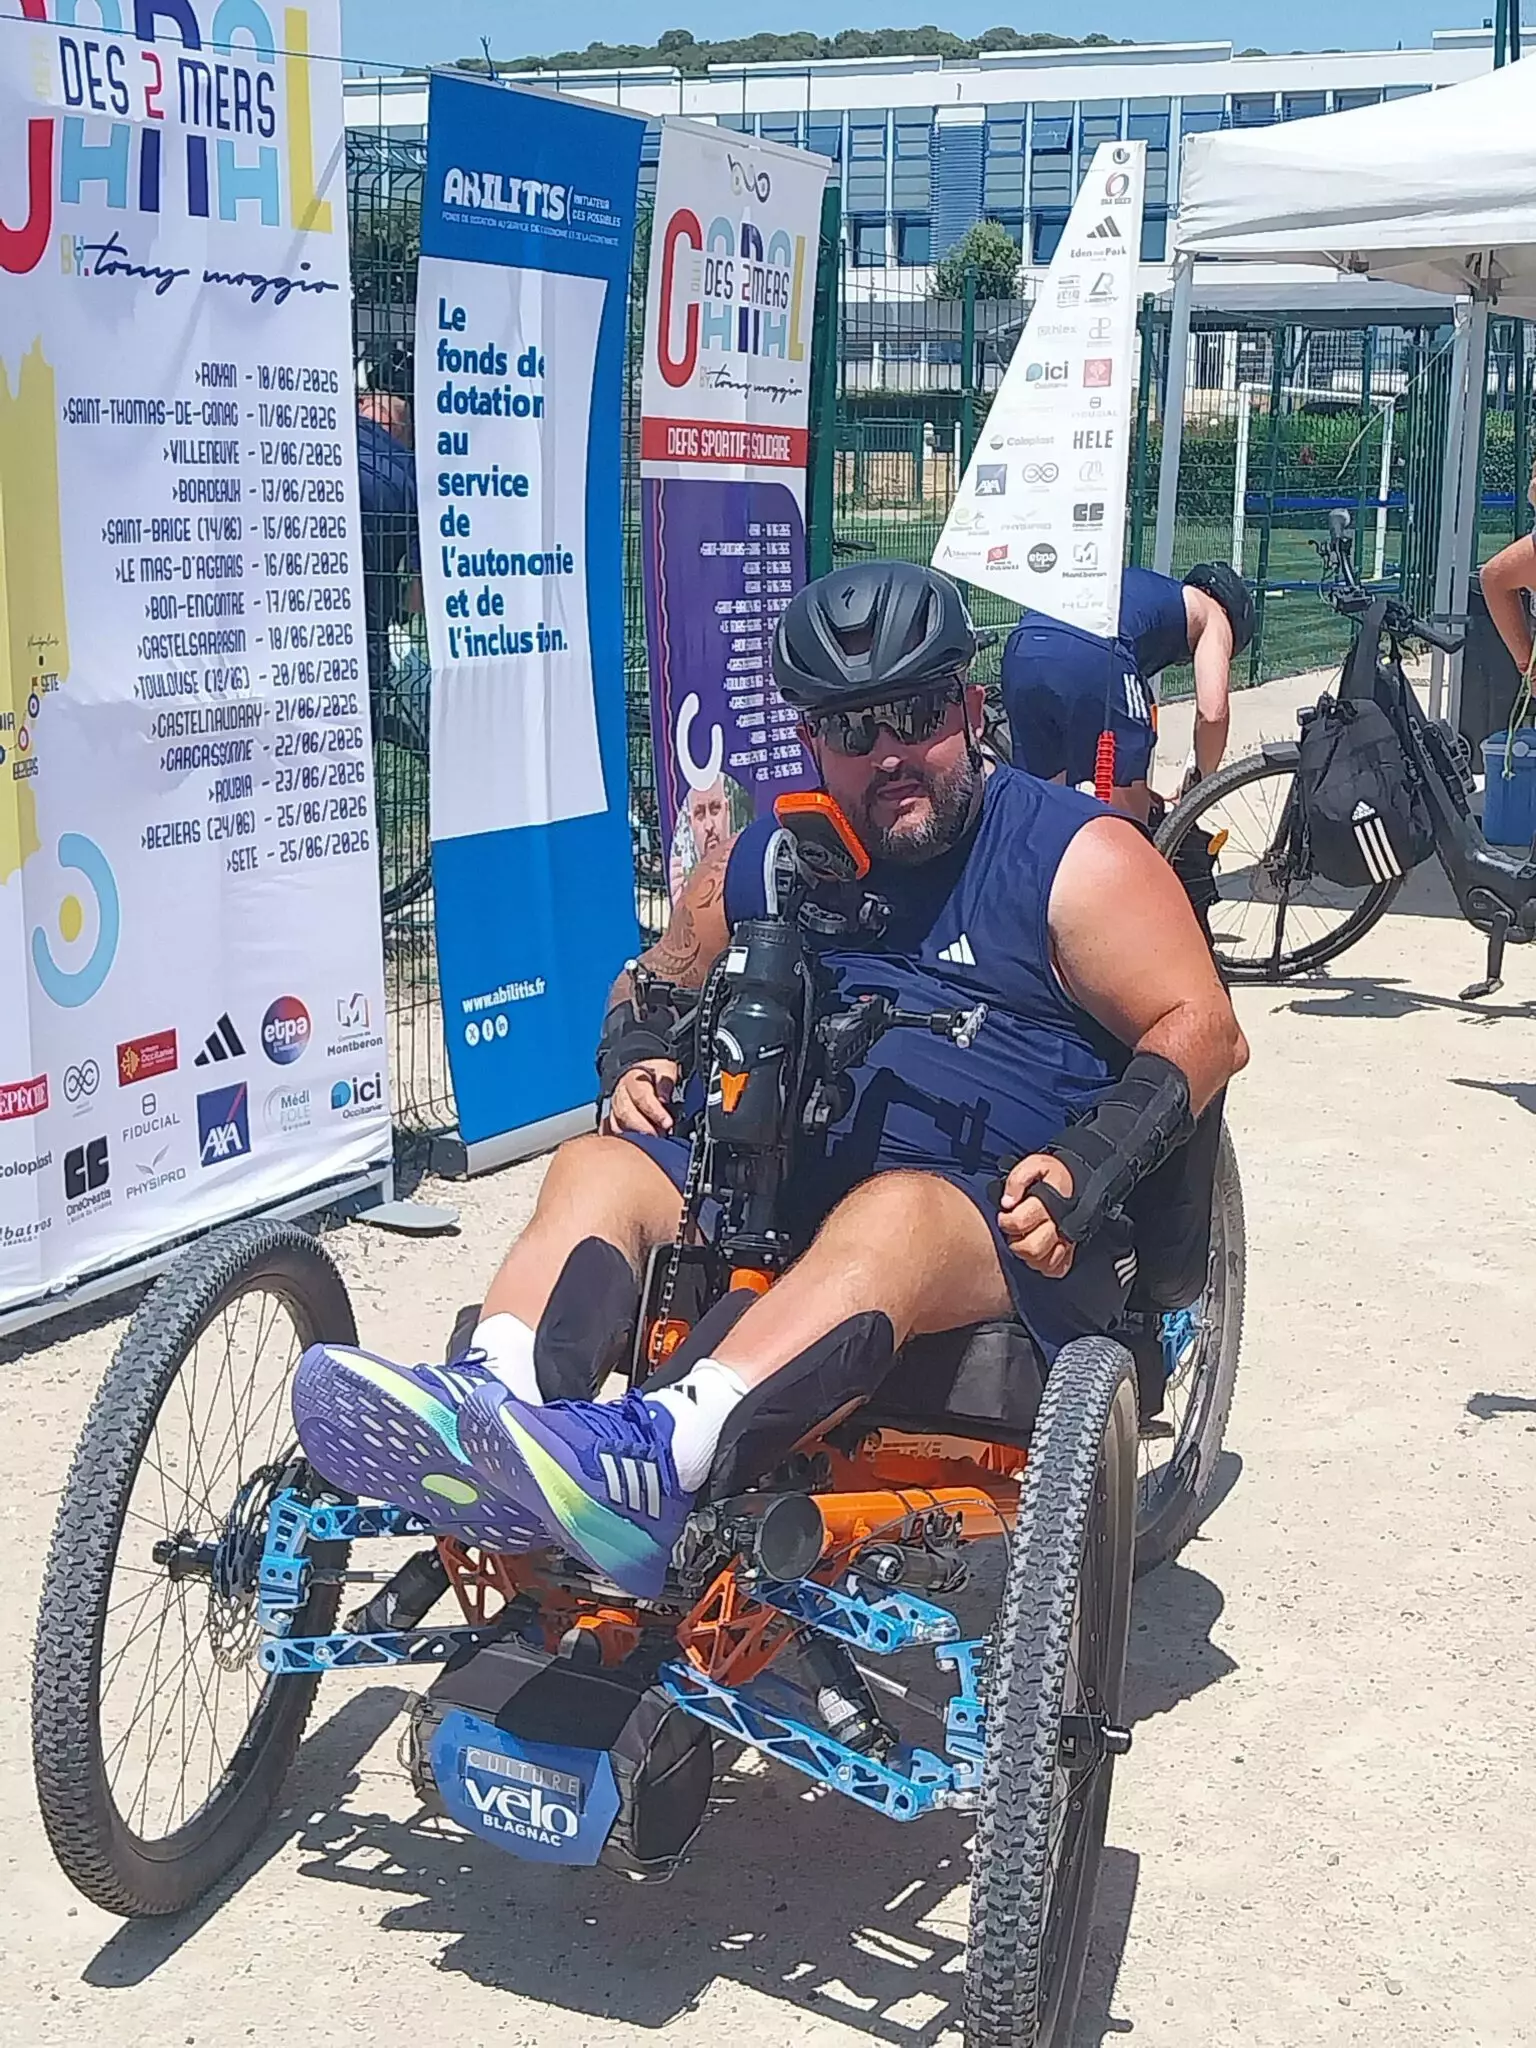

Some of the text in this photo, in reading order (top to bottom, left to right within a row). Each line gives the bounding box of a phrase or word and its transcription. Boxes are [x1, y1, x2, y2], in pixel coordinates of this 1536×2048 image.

[59, 36, 129, 114] DES
[141, 51, 164, 120] 2
[178, 57, 276, 138] MERS
[704, 258, 734, 299] DES
[741, 264, 751, 301] 2
[751, 266, 790, 310] MERS
[438, 298, 466, 331] Le
[436, 338, 507, 376] fonds
[1044, 360, 1069, 381] ici
[437, 381, 545, 418] dotation
[258, 403, 337, 430] 11/06/2026
[260, 441, 343, 466] 12/06/2026
[437, 431, 468, 455] au
[1073, 430, 1113, 449] HELE
[261, 479, 344, 502] 13/06/2026
[437, 465, 529, 497] service
[263, 516, 347, 539] 15/06/2026
[440, 505, 470, 537] de
[264, 552, 348, 576] 16/06/2026
[266, 587, 351, 613] 17/06/2026
[446, 584, 504, 618] et de
[268, 623, 353, 650] 18/06/2026
[271, 658, 358, 686] 20/06/2026
[275, 693, 358, 722] 21/06/2026
[275, 727, 363, 757] 22/06/2026
[275, 761, 365, 792] 23/06/2026
[207, 810, 255, 841] (24/06)
[276, 795, 367, 828] 25/06/2026
[279, 829, 370, 863] 25/06/2026
[462, 977, 546, 1014] www.abilitis.fr
[263, 1015, 308, 1043] etpa
[327, 1036, 383, 1056] Montberon
[352, 1072, 382, 1104] ici
[122, 1113, 181, 1142] FIDUCIAL
[201, 1122, 243, 1163] AXA
[126, 1167, 187, 1199] PHYSIPRO
[467, 1750, 578, 1795] CULTURE
[483, 1813, 562, 1847] BLAGNAC
